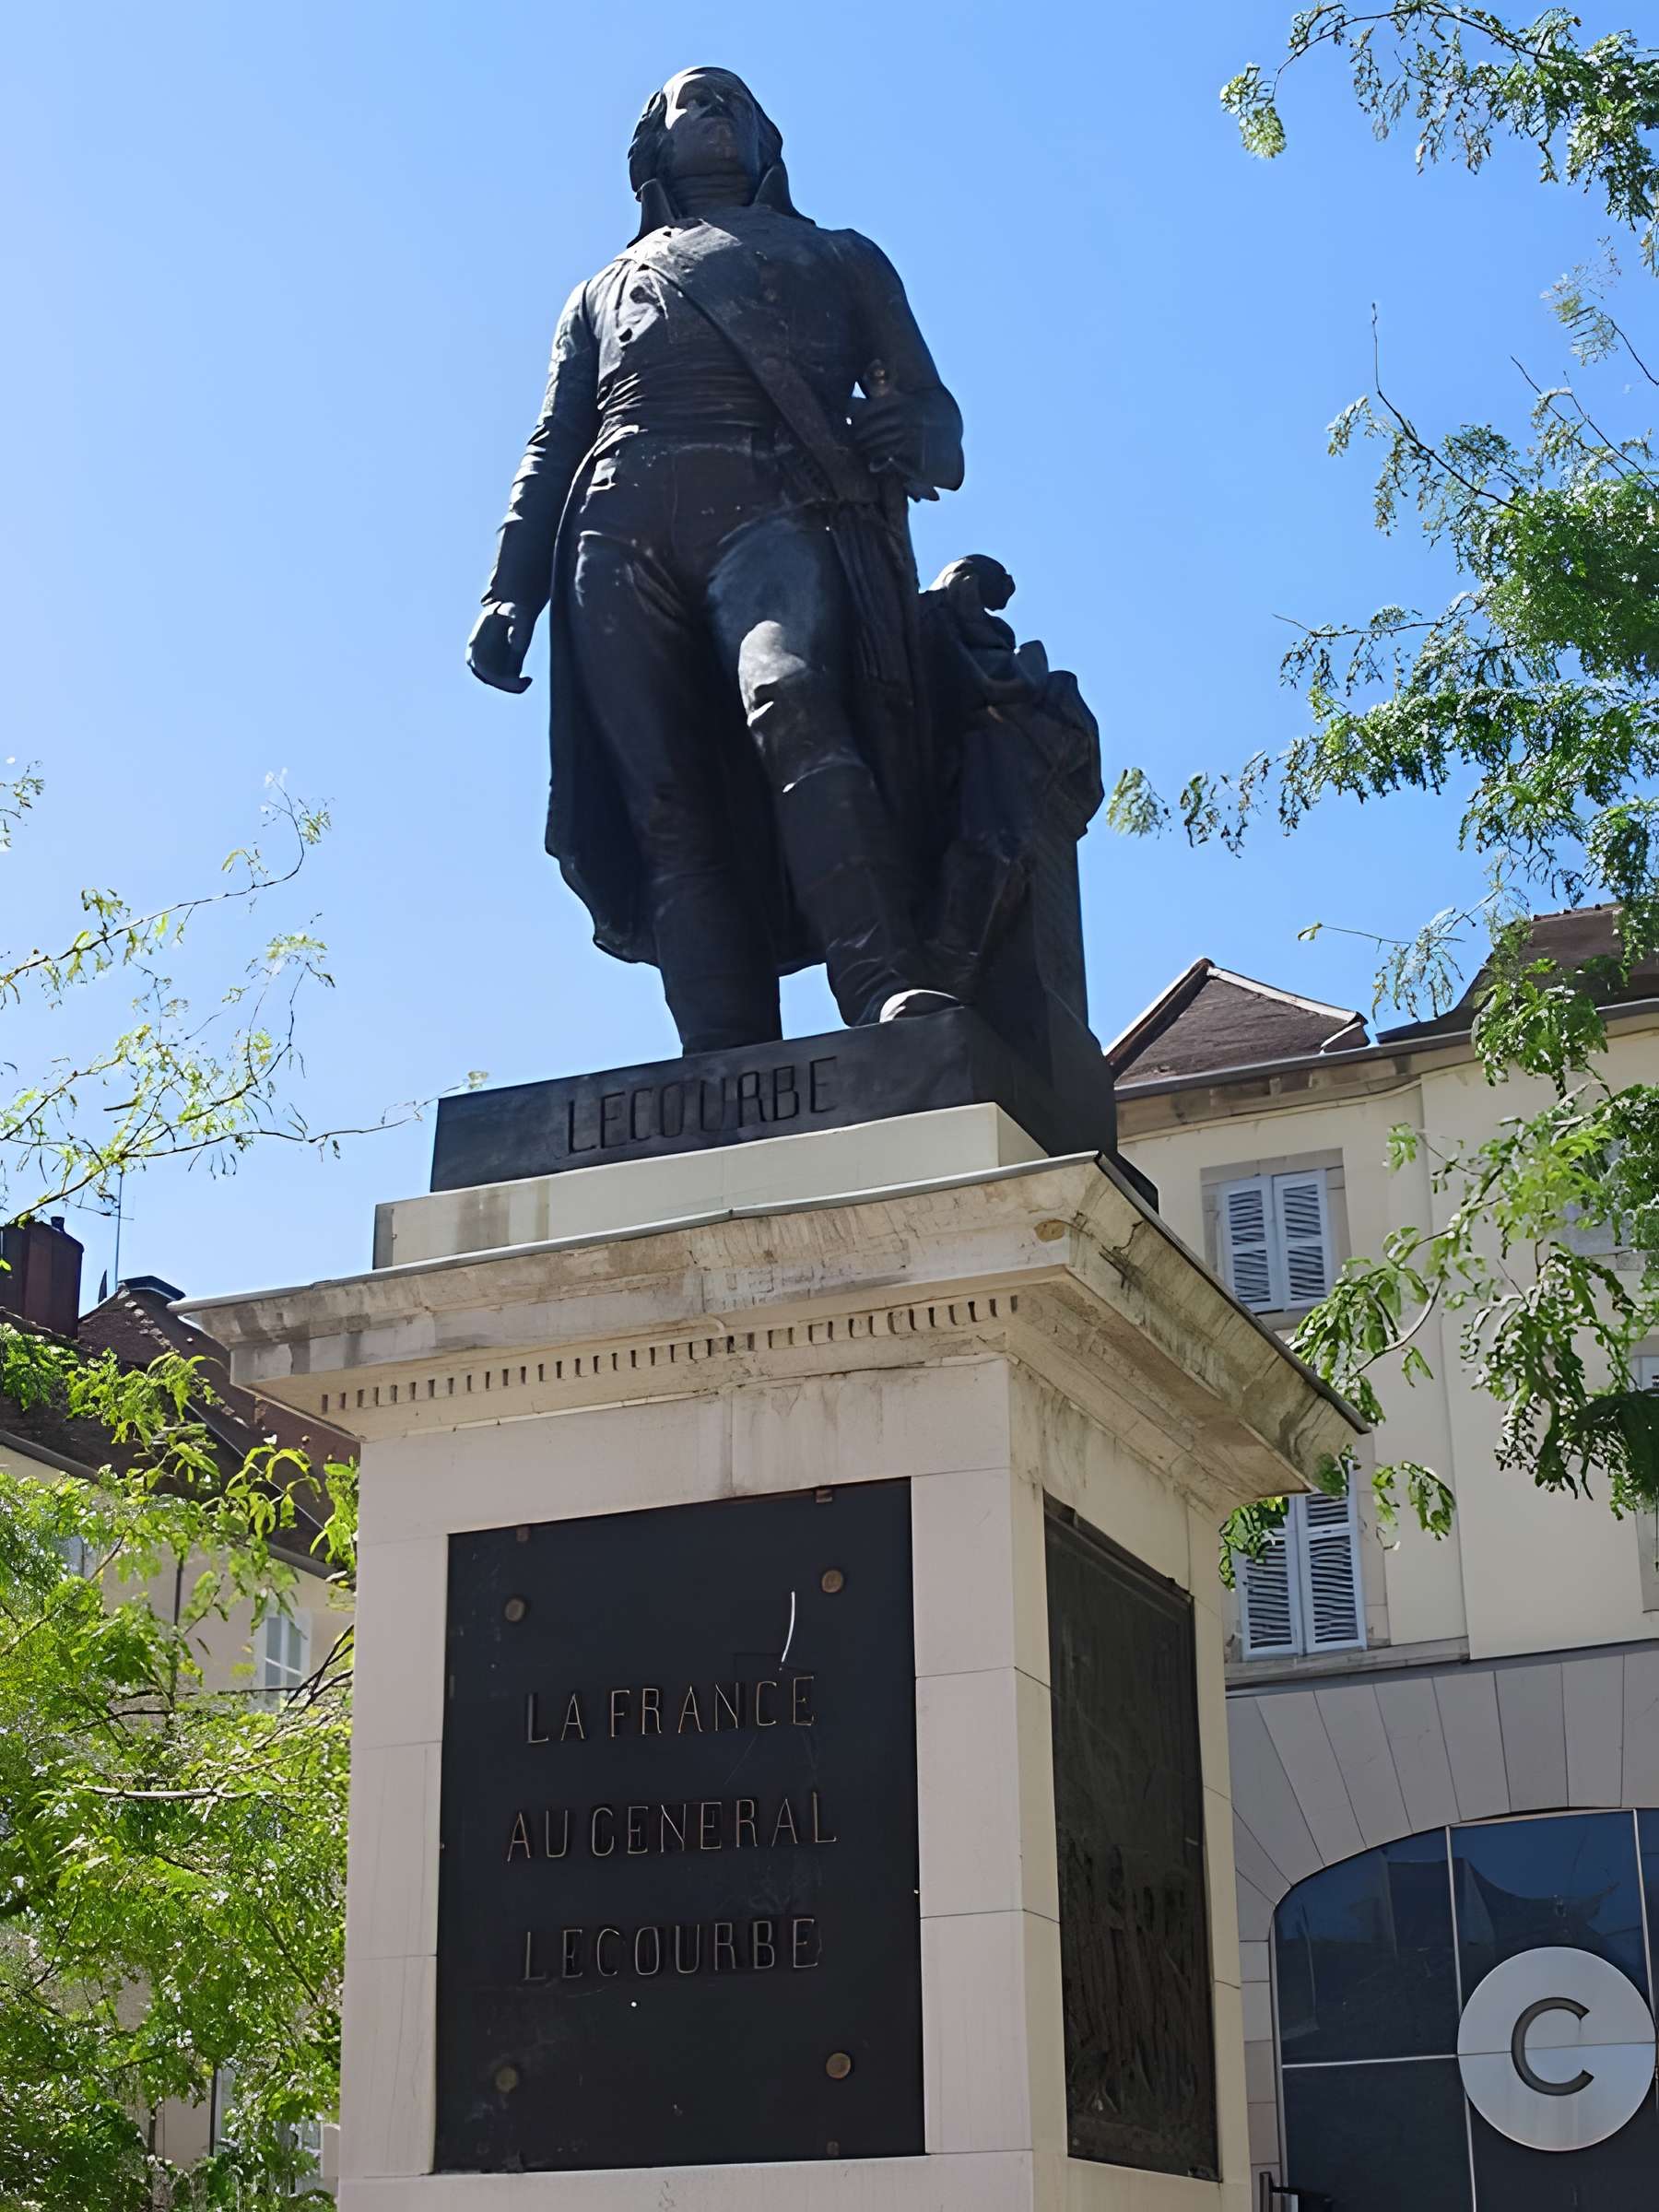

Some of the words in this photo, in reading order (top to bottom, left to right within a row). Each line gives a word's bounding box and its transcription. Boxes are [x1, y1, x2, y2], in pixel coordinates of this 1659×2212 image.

[568, 1055, 837, 1154] LECOURBE
[526, 1691, 585, 1744] LA
[610, 1675, 815, 1737] FRANCE
[507, 1809, 570, 1863] AU
[591, 1790, 838, 1857] GENERAL
[524, 1917, 819, 1981] LECOURBE
[1511, 1996, 1594, 2097] C
